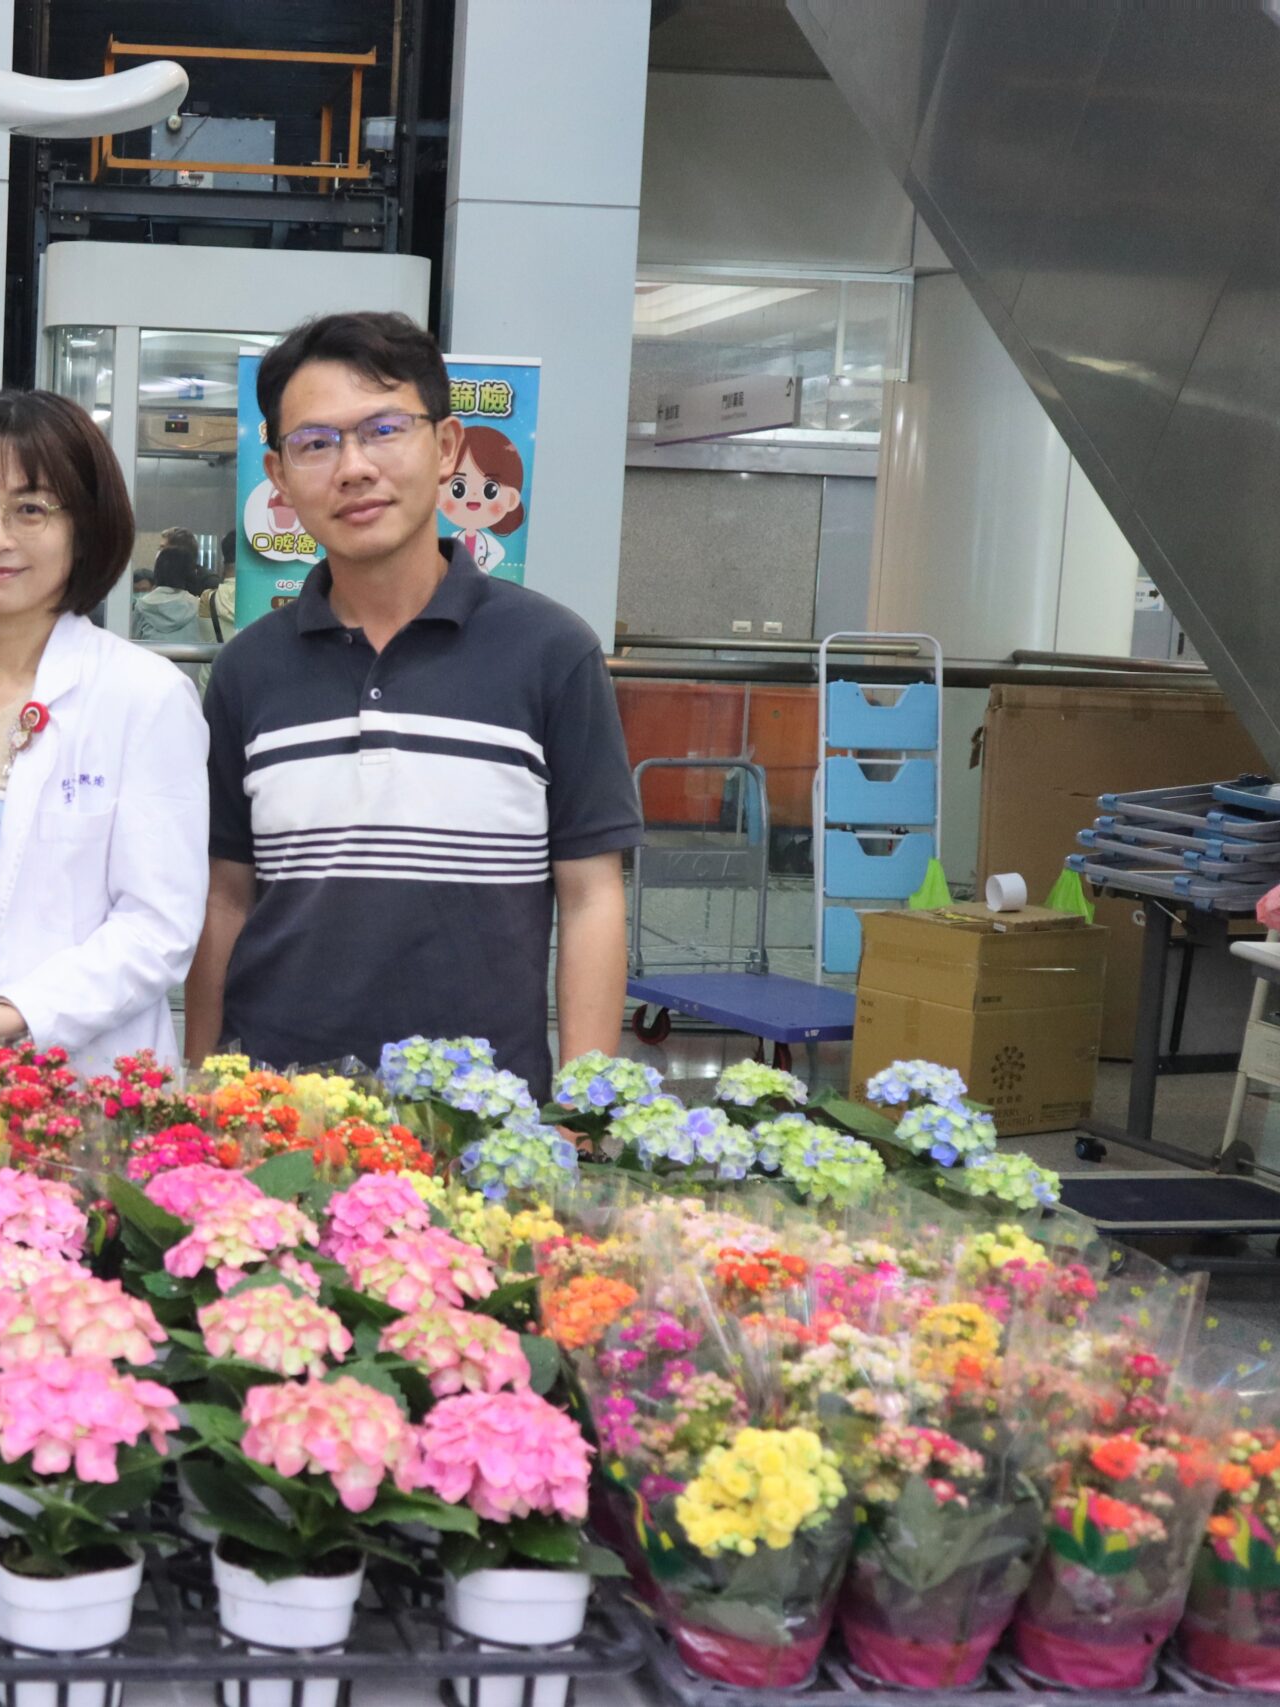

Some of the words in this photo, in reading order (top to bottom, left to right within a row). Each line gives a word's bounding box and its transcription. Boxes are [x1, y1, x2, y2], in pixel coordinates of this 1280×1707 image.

[449, 382, 511, 413] 篩檢
[252, 532, 318, 554] 口腔癌
